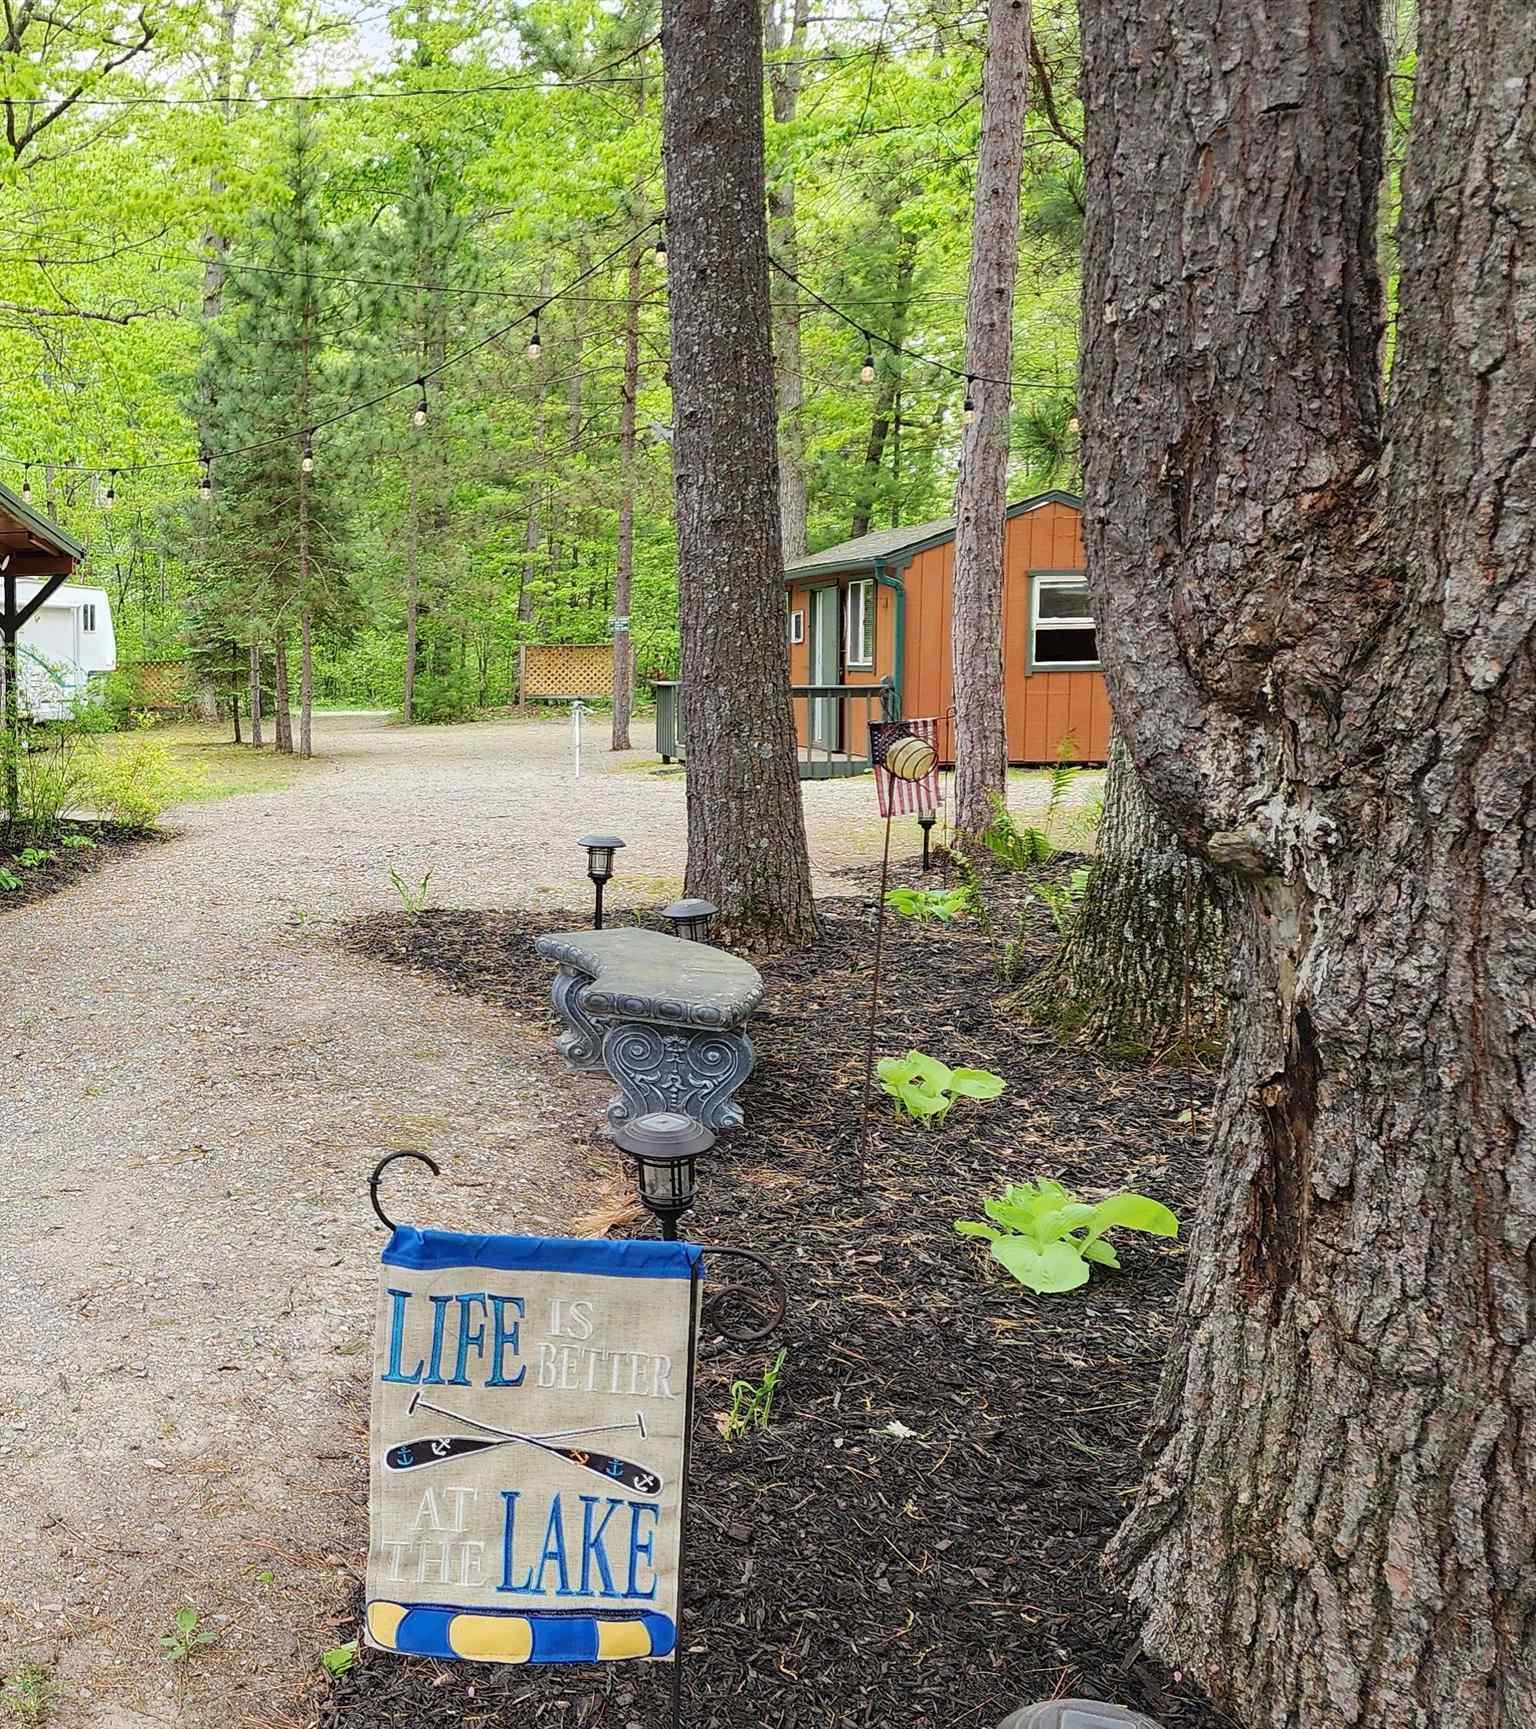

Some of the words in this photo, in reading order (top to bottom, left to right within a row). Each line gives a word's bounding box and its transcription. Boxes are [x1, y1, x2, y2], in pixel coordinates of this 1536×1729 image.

[381, 1289, 526, 1387] LIFE
[548, 1298, 594, 1341] IS
[537, 1343, 673, 1399] BETTER
[413, 1487, 479, 1532] AT
[383, 1540, 486, 1587] THE
[496, 1490, 660, 1599] LAKE
